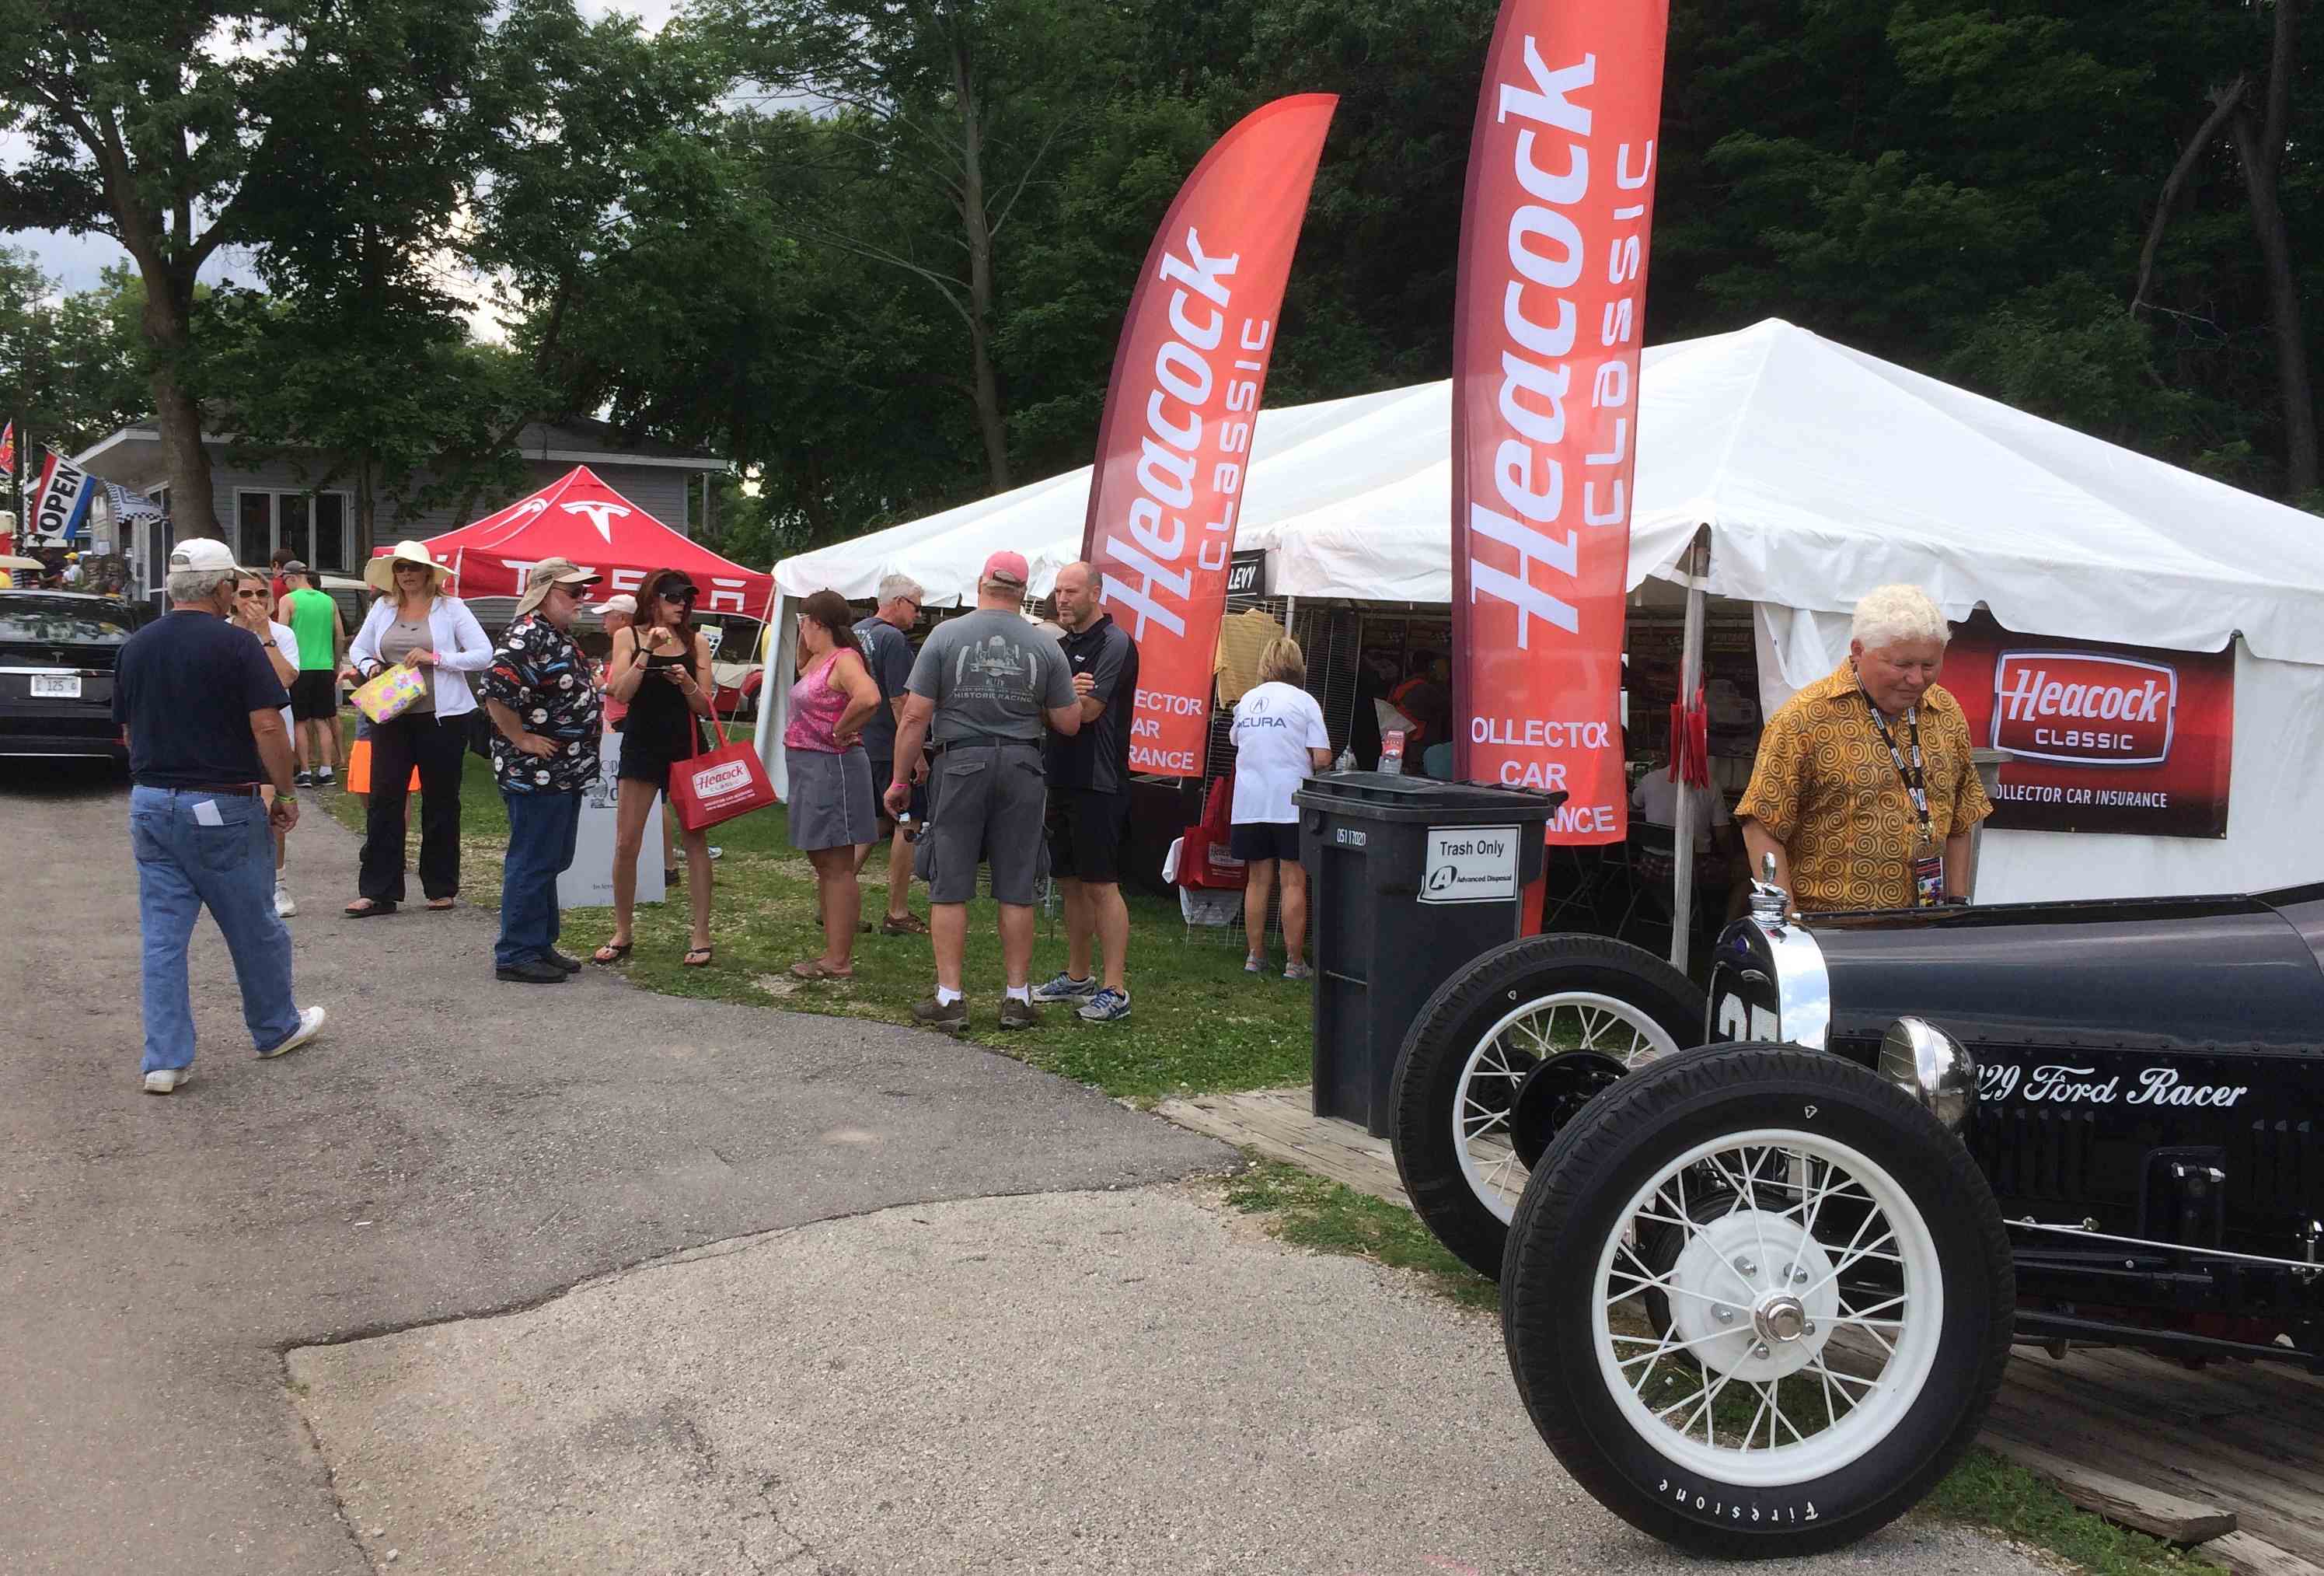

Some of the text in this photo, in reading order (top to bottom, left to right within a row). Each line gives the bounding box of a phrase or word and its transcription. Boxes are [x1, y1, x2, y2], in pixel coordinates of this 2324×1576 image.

[1467, 35, 1596, 651] Heacock
[1099, 225, 1239, 642] Heacock
[40, 463, 82, 533] OPEN
[1134, 688, 1202, 716] ECTOR
[2001, 669, 2165, 722] Heacock
[1131, 717, 1160, 739] AR
[1471, 716, 1610, 750] OLLECTOR
[1129, 744, 1195, 770] RANCE
[697, 766, 745, 790] Heacock
[1500, 760, 1567, 791] CAR
[2067, 788, 2091, 804] CAR
[2095, 790, 2168, 808] INSURANCE
[1440, 839, 1505, 858] Trash Only
[1457, 874, 1512, 883] Advanced Disposal
[2022, 1064, 2120, 1103] Ford
[2126, 1068, 2249, 1106] Racer
